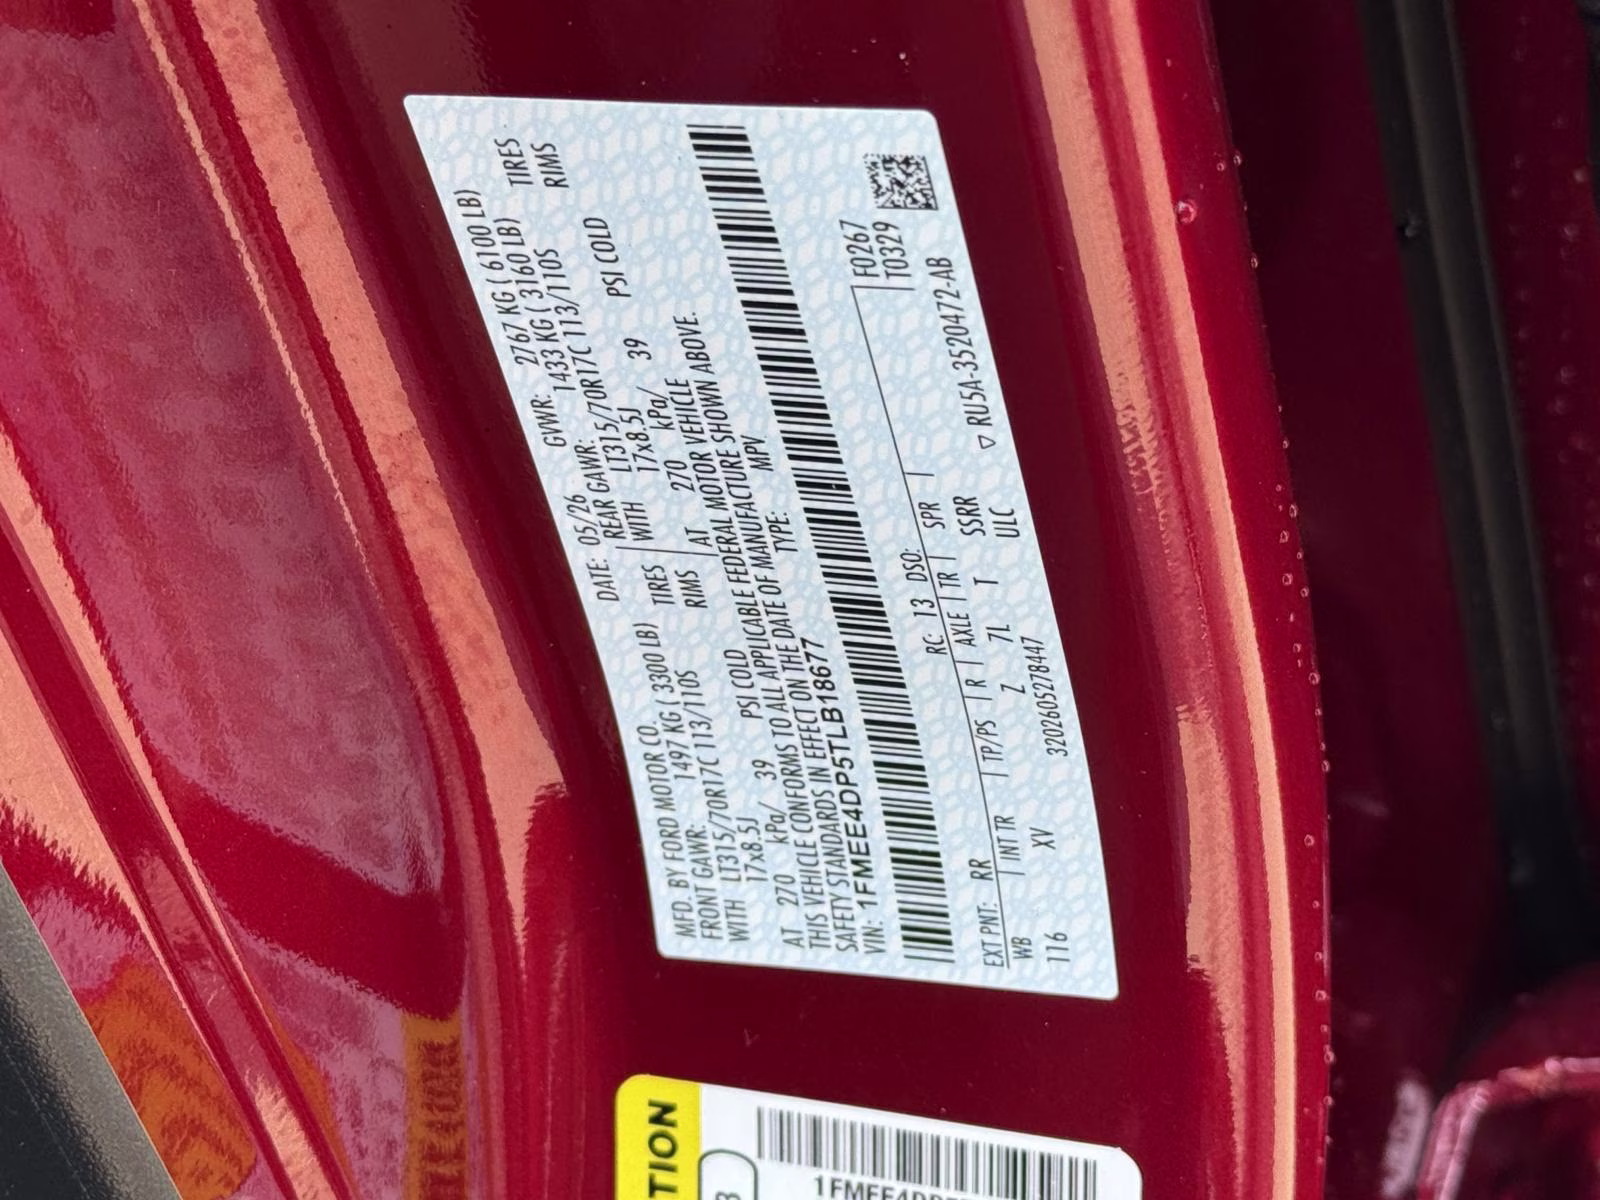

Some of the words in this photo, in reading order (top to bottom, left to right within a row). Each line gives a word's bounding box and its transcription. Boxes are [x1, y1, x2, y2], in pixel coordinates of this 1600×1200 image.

[494, 138, 533, 187] TIRES
[530, 143, 569, 188] RIMS
[454, 189, 486, 218] LB)
[467, 225, 503, 271] 6100
[493, 218, 525, 246] LB)
[583, 217, 619, 263] COLD
[839, 219, 880, 278] F0267
[872, 221, 912, 279] T0329
[506, 253, 543, 299] 3160
[533, 249, 586, 337] 113/110S
[601, 272, 631, 297] PSI
[491, 292, 520, 315] KG
[502, 322, 539, 366] 2767
[530, 319, 559, 342] KG
[623, 338, 652, 360] 39
[673, 312, 715, 375] ABOVE.
[925, 257, 993, 426] RU5A-3520472-AB
[541, 349, 576, 391] 1433
[530, 394, 566, 447] GVWR:
[567, 345, 632, 472] LT315/70R17C
[636, 386, 675, 430] kPa/
[664, 378, 707, 445] VEHICLE
[694, 380, 736, 443] SHOWN
[617, 408, 660, 472] 17x8.5J
[740, 434, 774, 472] MPV
[574, 439, 609, 493] GAWR:
[664, 459, 695, 492] 270
[689, 452, 729, 511] MOTOR
[564, 494, 600, 546] 05/26
[593, 500, 626, 540] REAR
[621, 502, 654, 541] WITH
[716, 450, 775, 570] MANUFACTURE
[918, 502, 946, 529] SPR
[953, 496, 986, 536] SSRR
[989, 507, 1020, 538] ULC
[684, 527, 713, 547] AT
[710, 517, 751, 584] FEDERAL
[765, 511, 798, 552] TYPE:
[586, 558, 620, 601] DATE:
[641, 564, 675, 605] TIRES
[900, 548, 928, 581] DSO:
[937, 572, 961, 588] TR
[973, 576, 998, 586] T
[674, 570, 708, 608] RIMS
[755, 575, 782, 595] OF
[762, 600, 796, 639] DATE
[910, 599, 937, 617] 13
[633, 622, 665, 647] LB)
[731, 589, 780, 680] APPLICABLE
[923, 634, 948, 655] RC:
[947, 611, 977, 647] AXLE
[986, 624, 1013, 643] 7L
[643, 653, 674, 693] 3300
[723, 649, 755, 689] COLD
[775, 644, 805, 672] THE
[760, 687, 789, 713] ALL
[785, 678, 812, 701] ON
[965, 679, 987, 688] R
[1000, 684, 1026, 694] Z
[1021, 637, 1069, 757] 3202605278447
[659, 711, 685, 733] KG
[674, 670, 715, 749] 113/110S
[736, 696, 763, 719] PSI
[769, 718, 794, 737] TO
[637, 721, 659, 746] CO.
[792, 707, 827, 759] EFFECT
[974, 719, 1004, 761] TP/PS
[666, 740, 696, 780] 1497
[752, 759, 777, 781] 39
[800, 637, 878, 910] 1FMEE4DP5TLB18677
[807, 766, 832, 783] IN
[644, 752, 678, 811] MOTOR
[776, 744, 814, 833] CONFORMS
[697, 756, 742, 882] LT315/70R17C
[759, 802, 789, 844] kPa/
[812, 790, 849, 887] STANDARDS
[994, 816, 1016, 831] TR
[1029, 827, 1056, 849] XV
[657, 817, 685, 862] FORD
[685, 824, 714, 878] GAWR:
[737, 817, 768, 882] 17x8.5J
[997, 838, 1021, 861] INT
[666, 867, 690, 888] BY
[774, 874, 798, 906] 270
[794, 839, 826, 906] VEHICLE
[968, 859, 994, 881] RR
[671, 897, 696, 938] MFD.
[694, 884, 723, 940] FRONT
[723, 900, 750, 942] WITH
[805, 913, 831, 949] THIS
[828, 892, 859, 952] SAFETY
[977, 902, 1000, 936] PNT:
[781, 927, 805, 948] AT
[862, 920, 887, 954] VIN:
[980, 939, 1004, 968] EXT
[1011, 937, 1033, 960] WB
[1044, 932, 1071, 963] 116
[648, 1100, 678, 1198] TION
